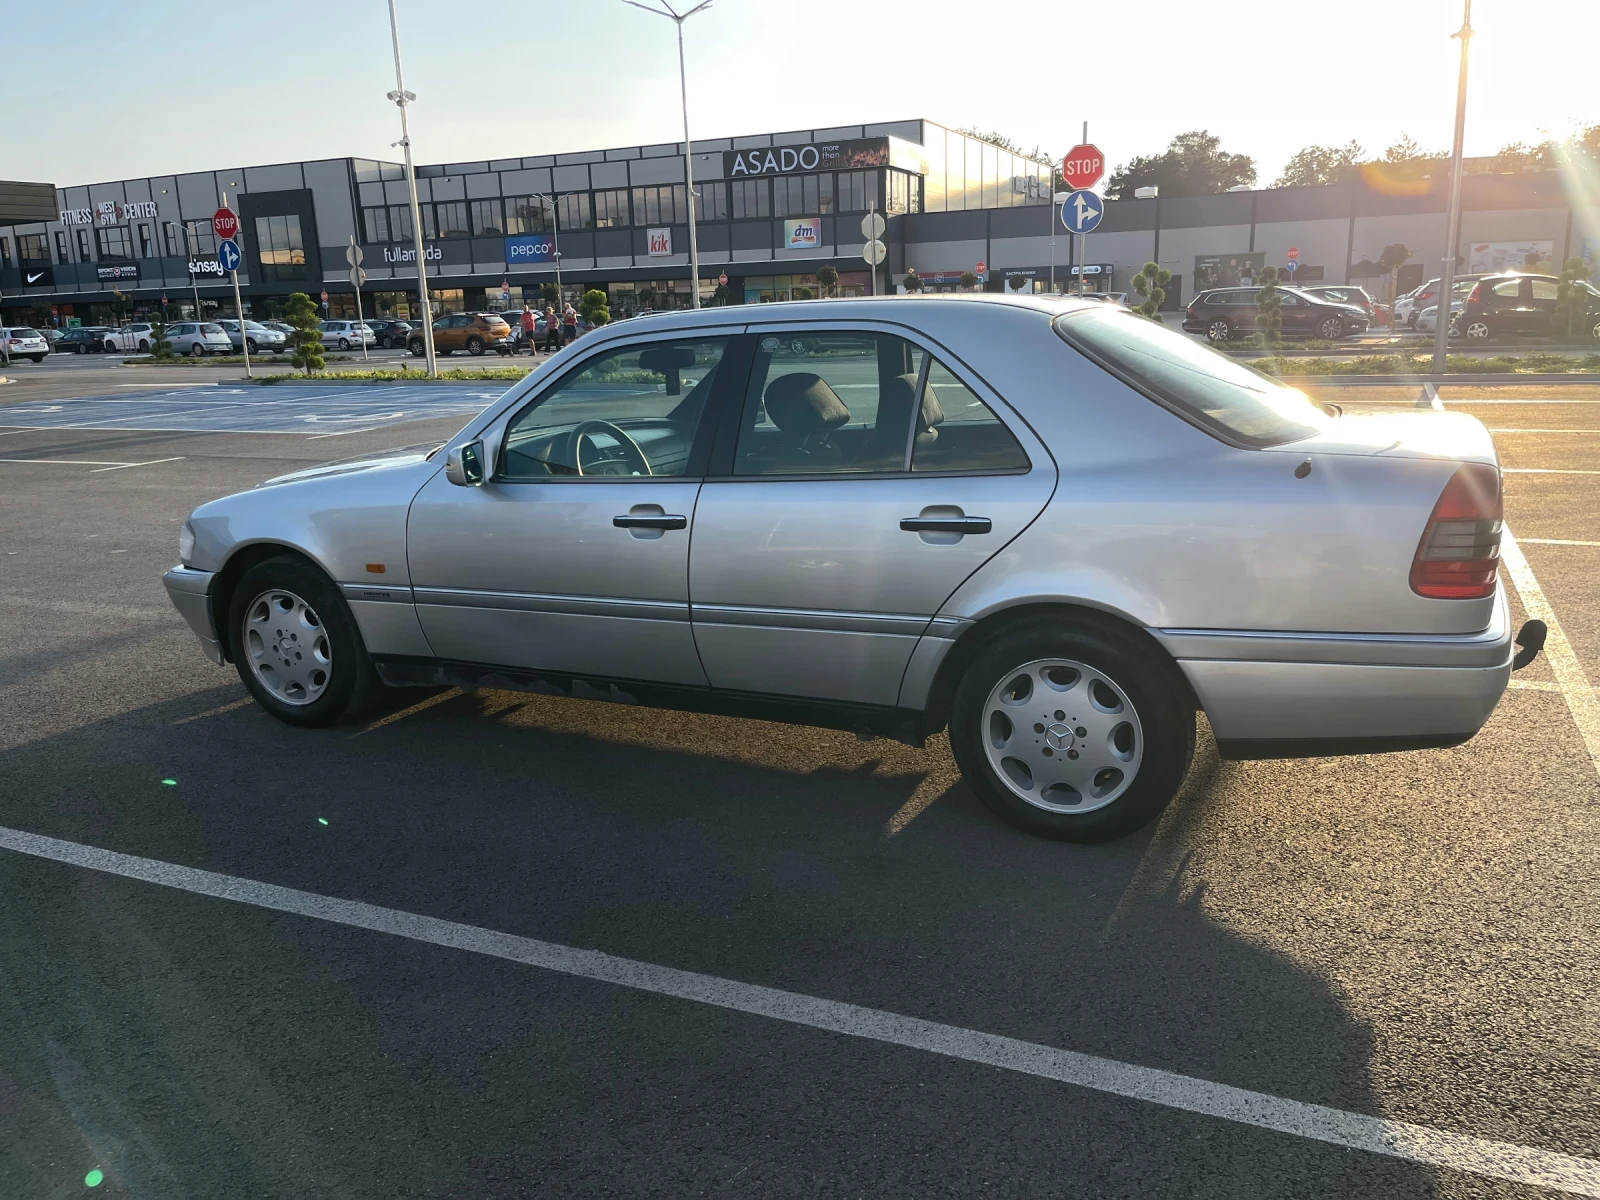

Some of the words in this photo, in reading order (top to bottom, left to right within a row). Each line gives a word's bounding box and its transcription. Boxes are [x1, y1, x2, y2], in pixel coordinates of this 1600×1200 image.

[731, 145, 820, 176] ASADO
[822, 158, 841, 168] Grill
[1066, 158, 1100, 176] STOP
[60, 208, 92, 226] FITNESS
[124, 202, 157, 219] CENTER
[98, 201, 115, 213] WEST
[101, 213, 117, 225] GYM
[215, 217, 235, 230] STOP
[794, 225, 813, 237] dm
[651, 231, 668, 252] kik
[511, 243, 549, 258] pepco
[188, 258, 224, 276] sinsay
